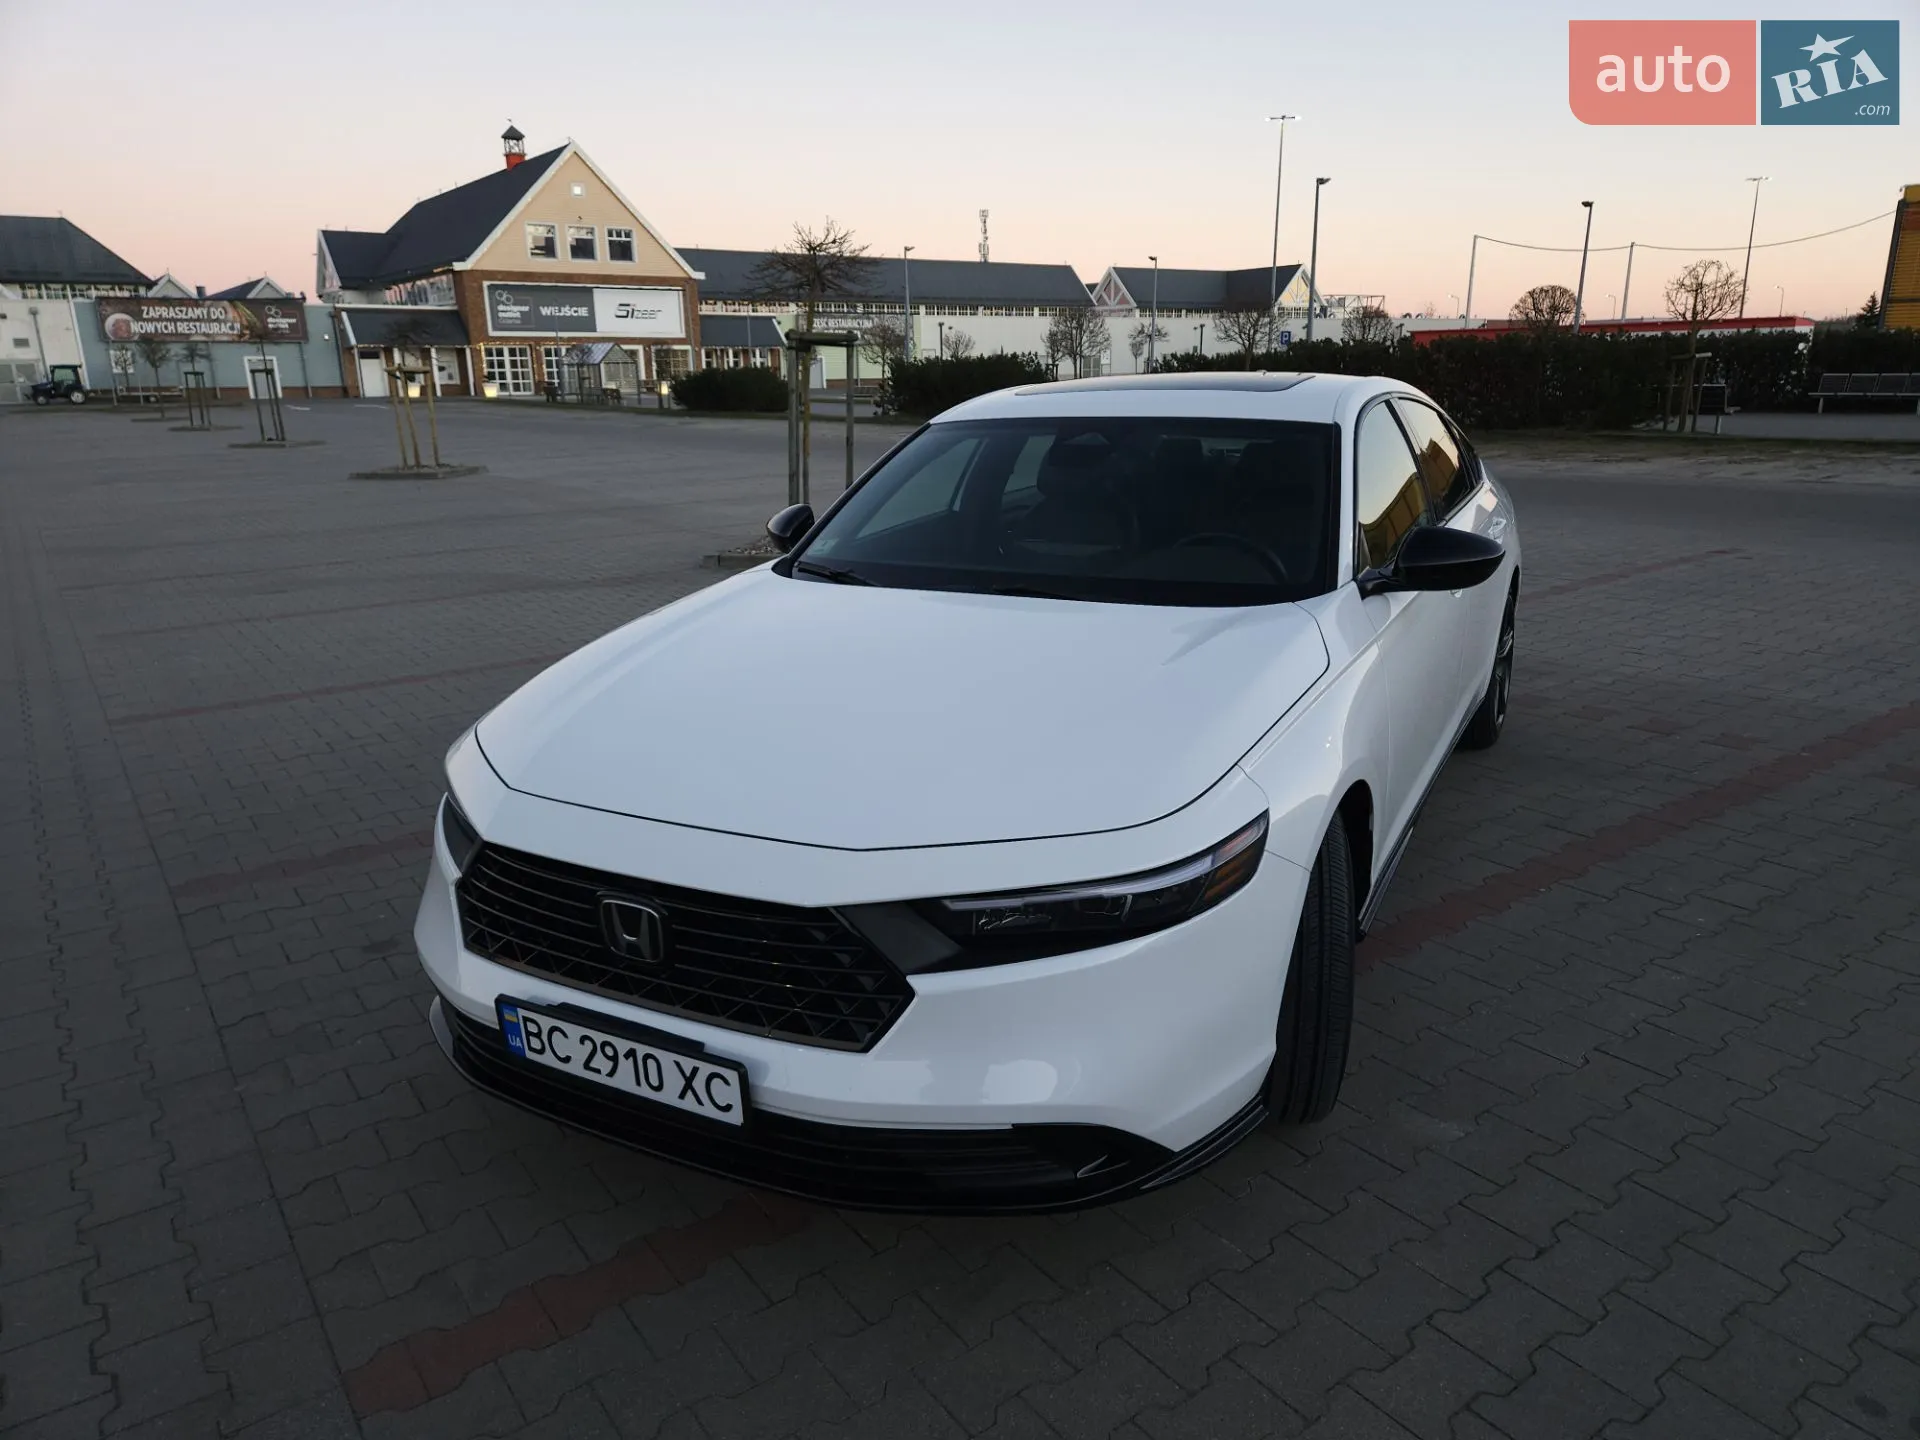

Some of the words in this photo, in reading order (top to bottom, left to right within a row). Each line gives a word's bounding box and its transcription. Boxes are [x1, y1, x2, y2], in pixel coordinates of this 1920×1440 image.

[141, 306, 208, 319] ZAPRASZAMY
[209, 307, 225, 319] DO
[497, 304, 529, 312] designer
[539, 305, 589, 316] WEJŚCIE
[130, 321, 176, 334] NOWYCH
[508, 1034, 523, 1049] UA
[522, 1015, 572, 1064] BC
[579, 1034, 664, 1092] 2910
[673, 1059, 733, 1113] XC
